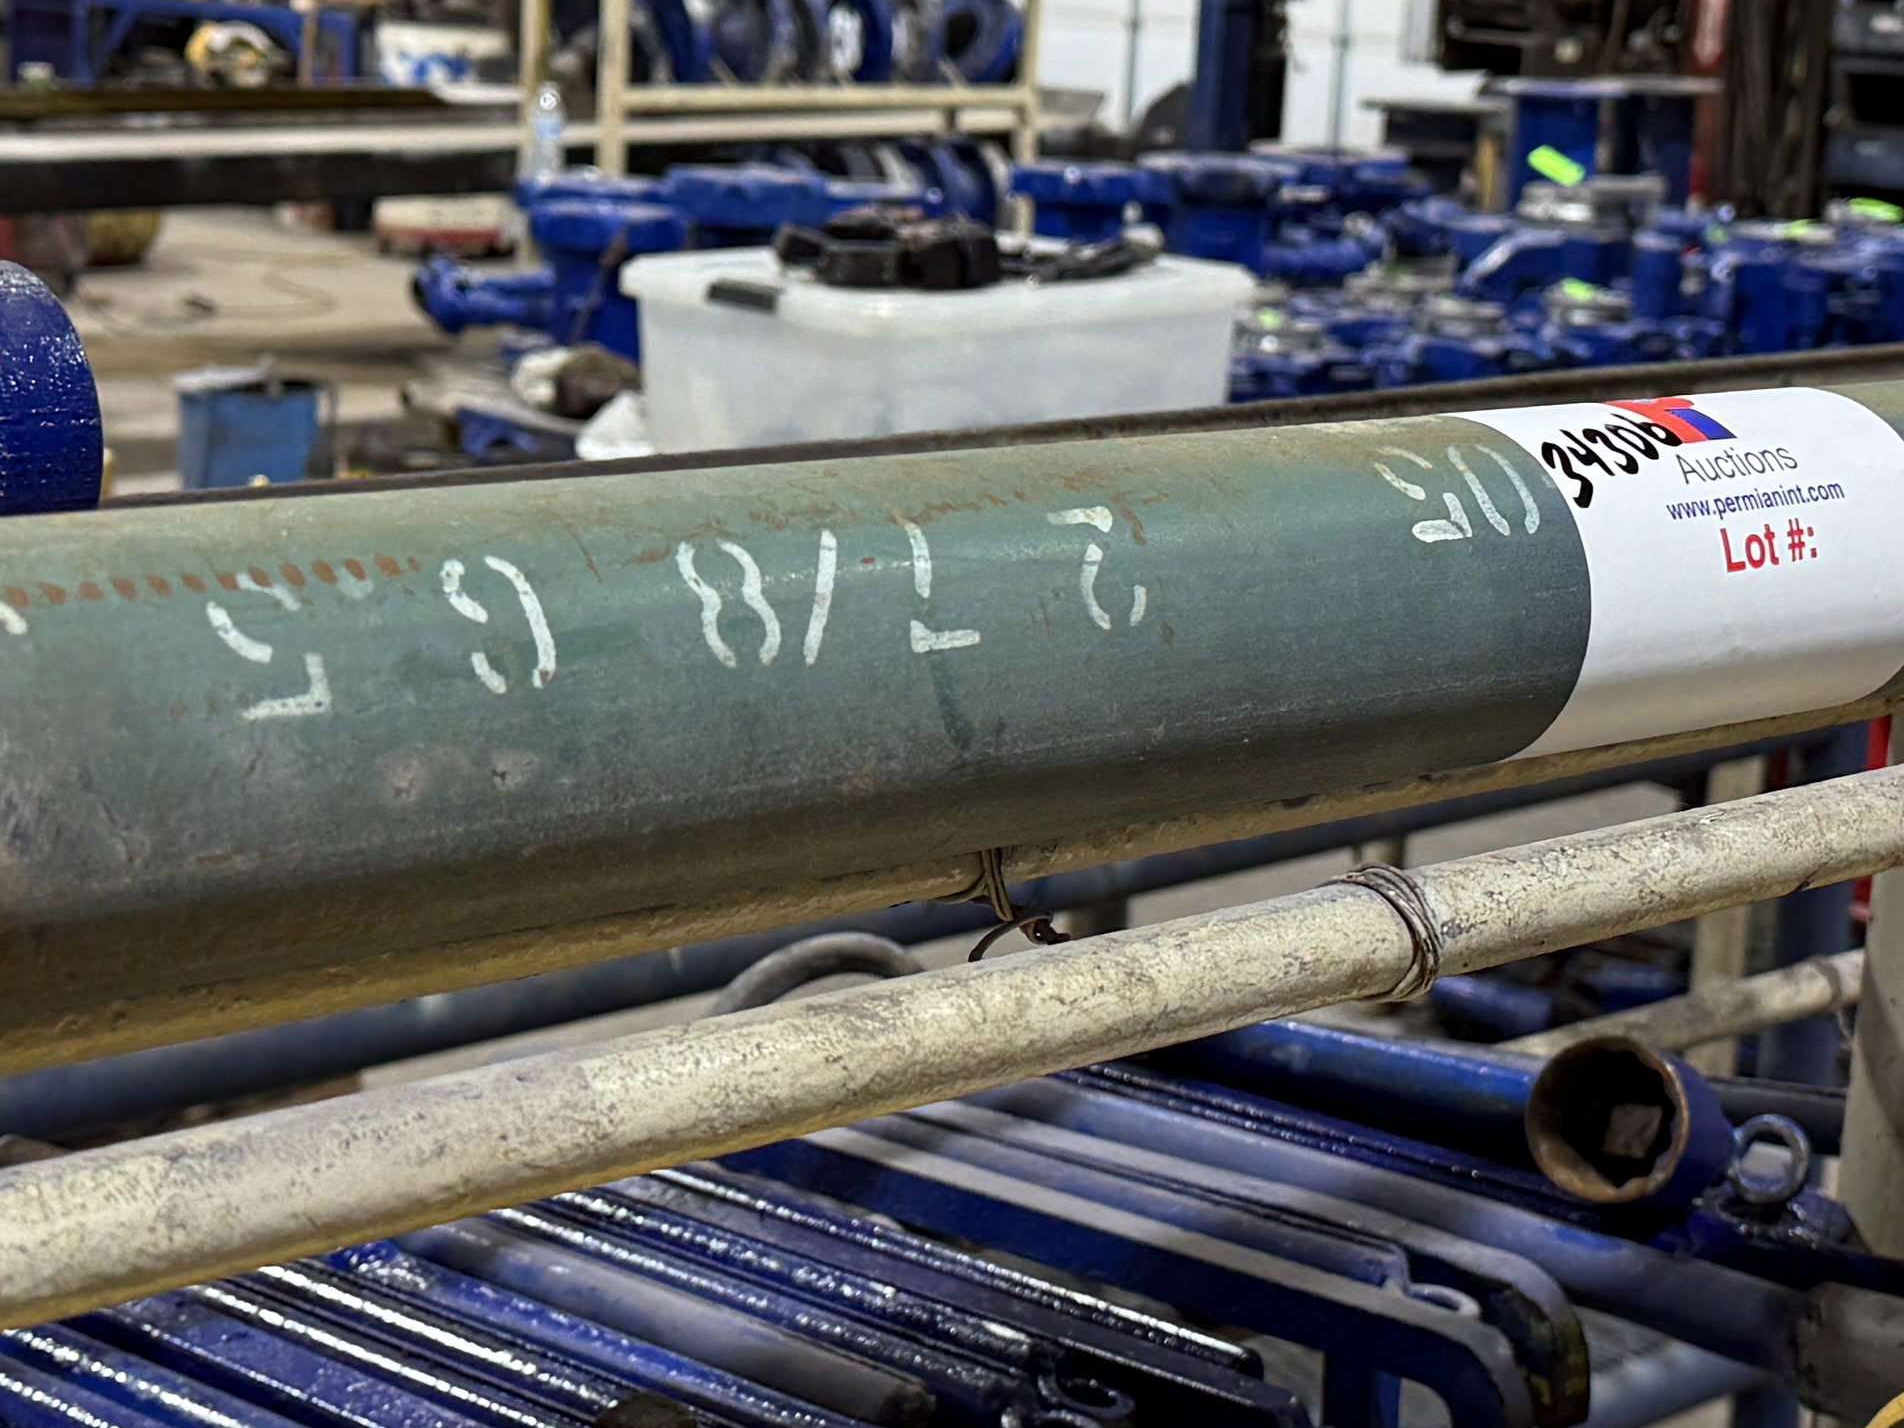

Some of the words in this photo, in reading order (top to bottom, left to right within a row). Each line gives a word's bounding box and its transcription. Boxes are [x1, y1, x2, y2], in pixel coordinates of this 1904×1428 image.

[1676, 441, 1800, 486] Auctions
[1666, 478, 1846, 522] www.permianint.com
[1046, 504, 1148, 630] 2
[1721, 526, 1780, 573] Lot
[1787, 518, 1818, 563] #:
